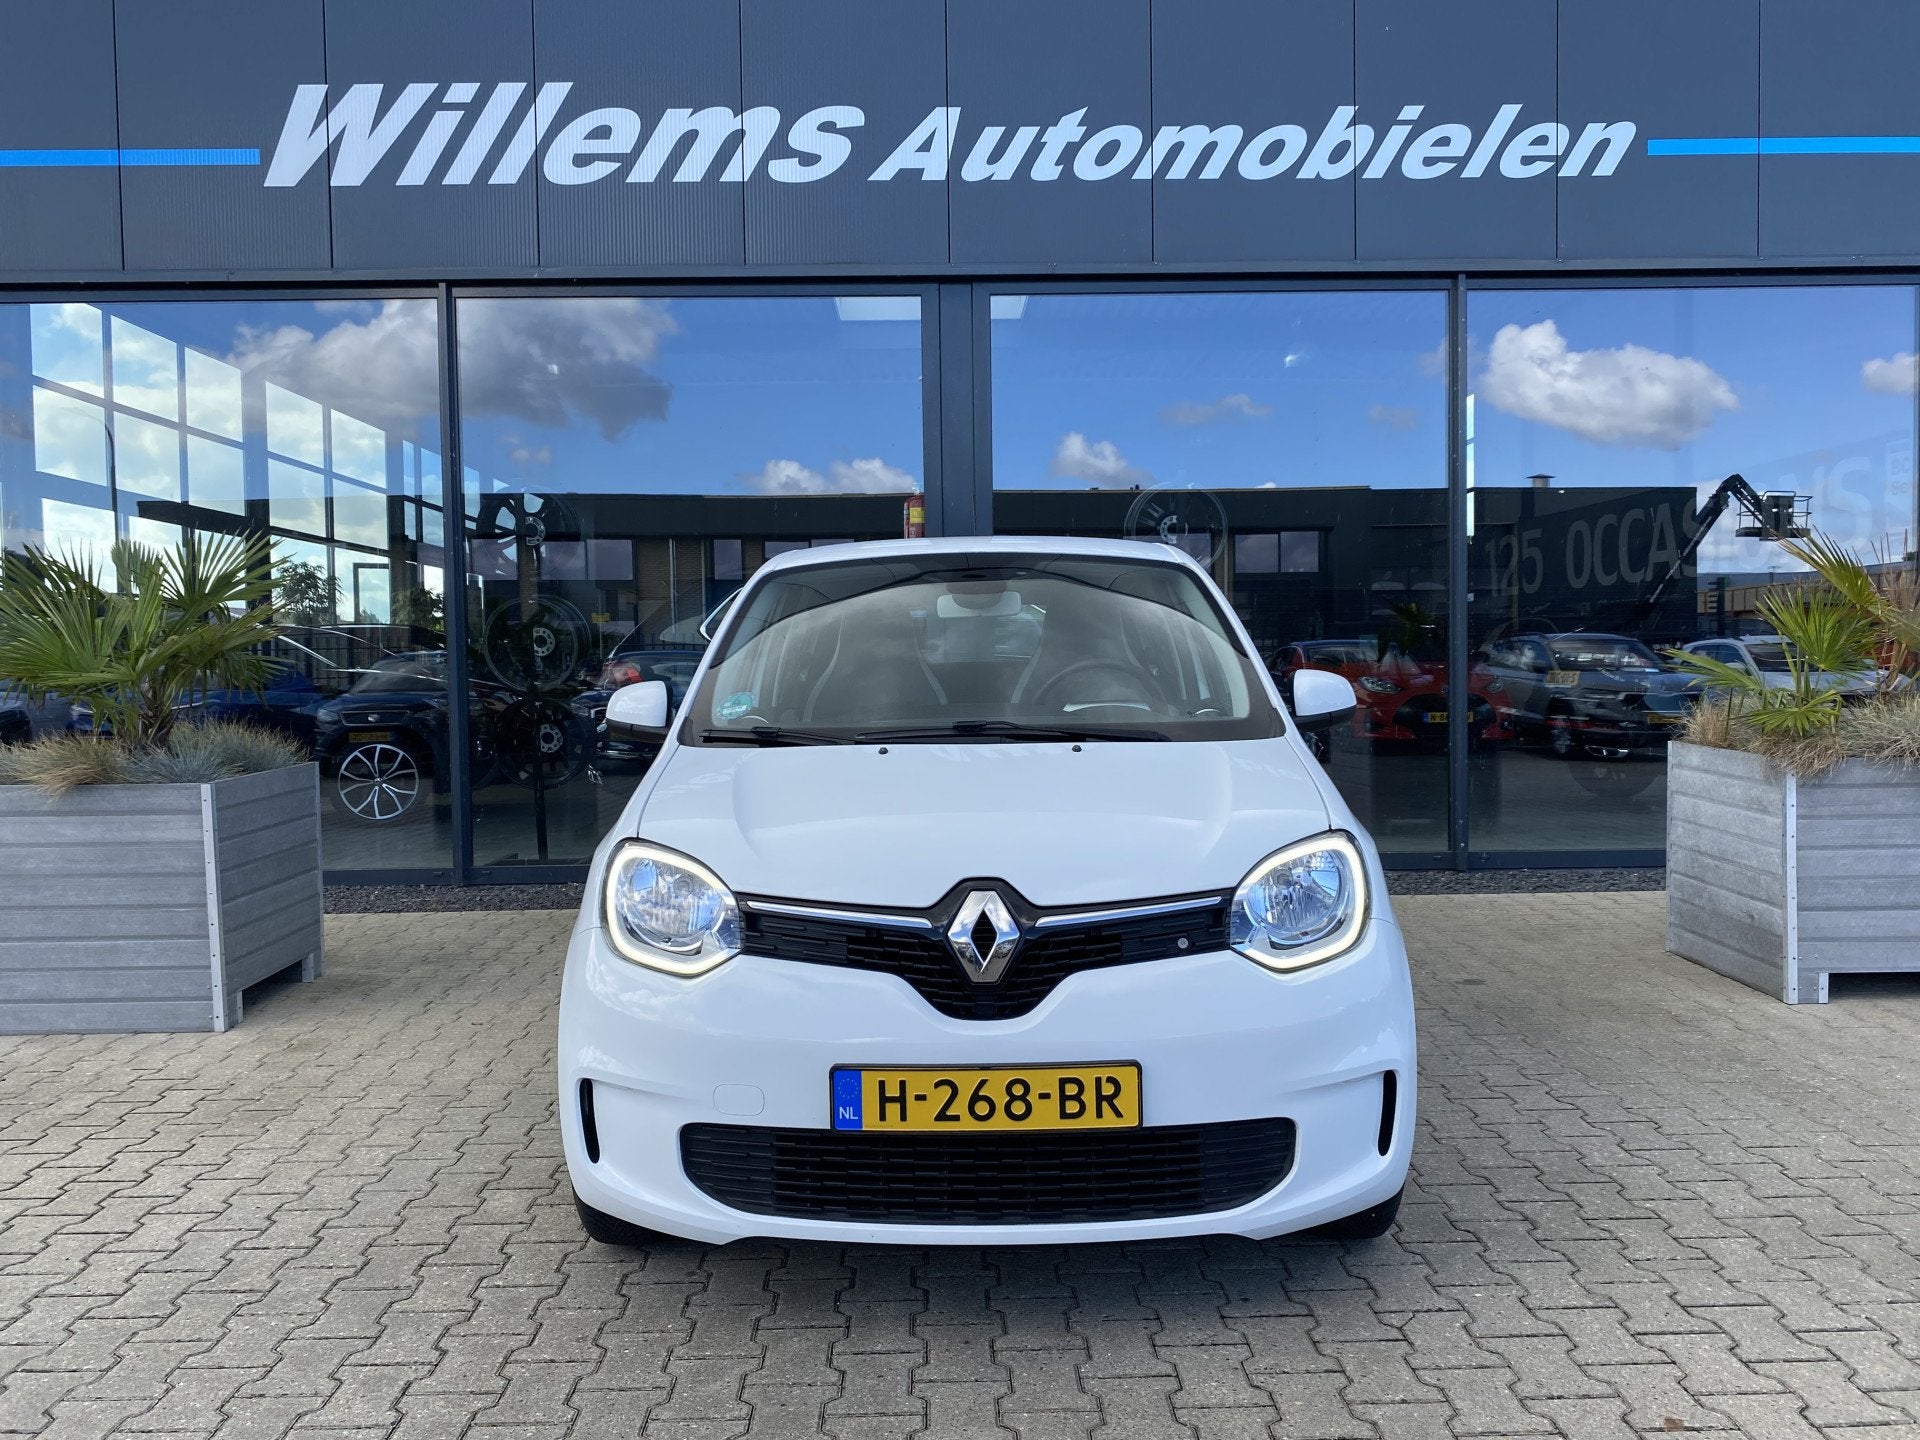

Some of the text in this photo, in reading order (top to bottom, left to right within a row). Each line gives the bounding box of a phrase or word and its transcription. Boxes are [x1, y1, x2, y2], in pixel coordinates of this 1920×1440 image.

[264, 81, 1637, 187] Willems Automobielen
[1485, 528, 1543, 597] 125
[839, 1106, 859, 1121] NL
[878, 1075, 1124, 1122] H-268-BR
